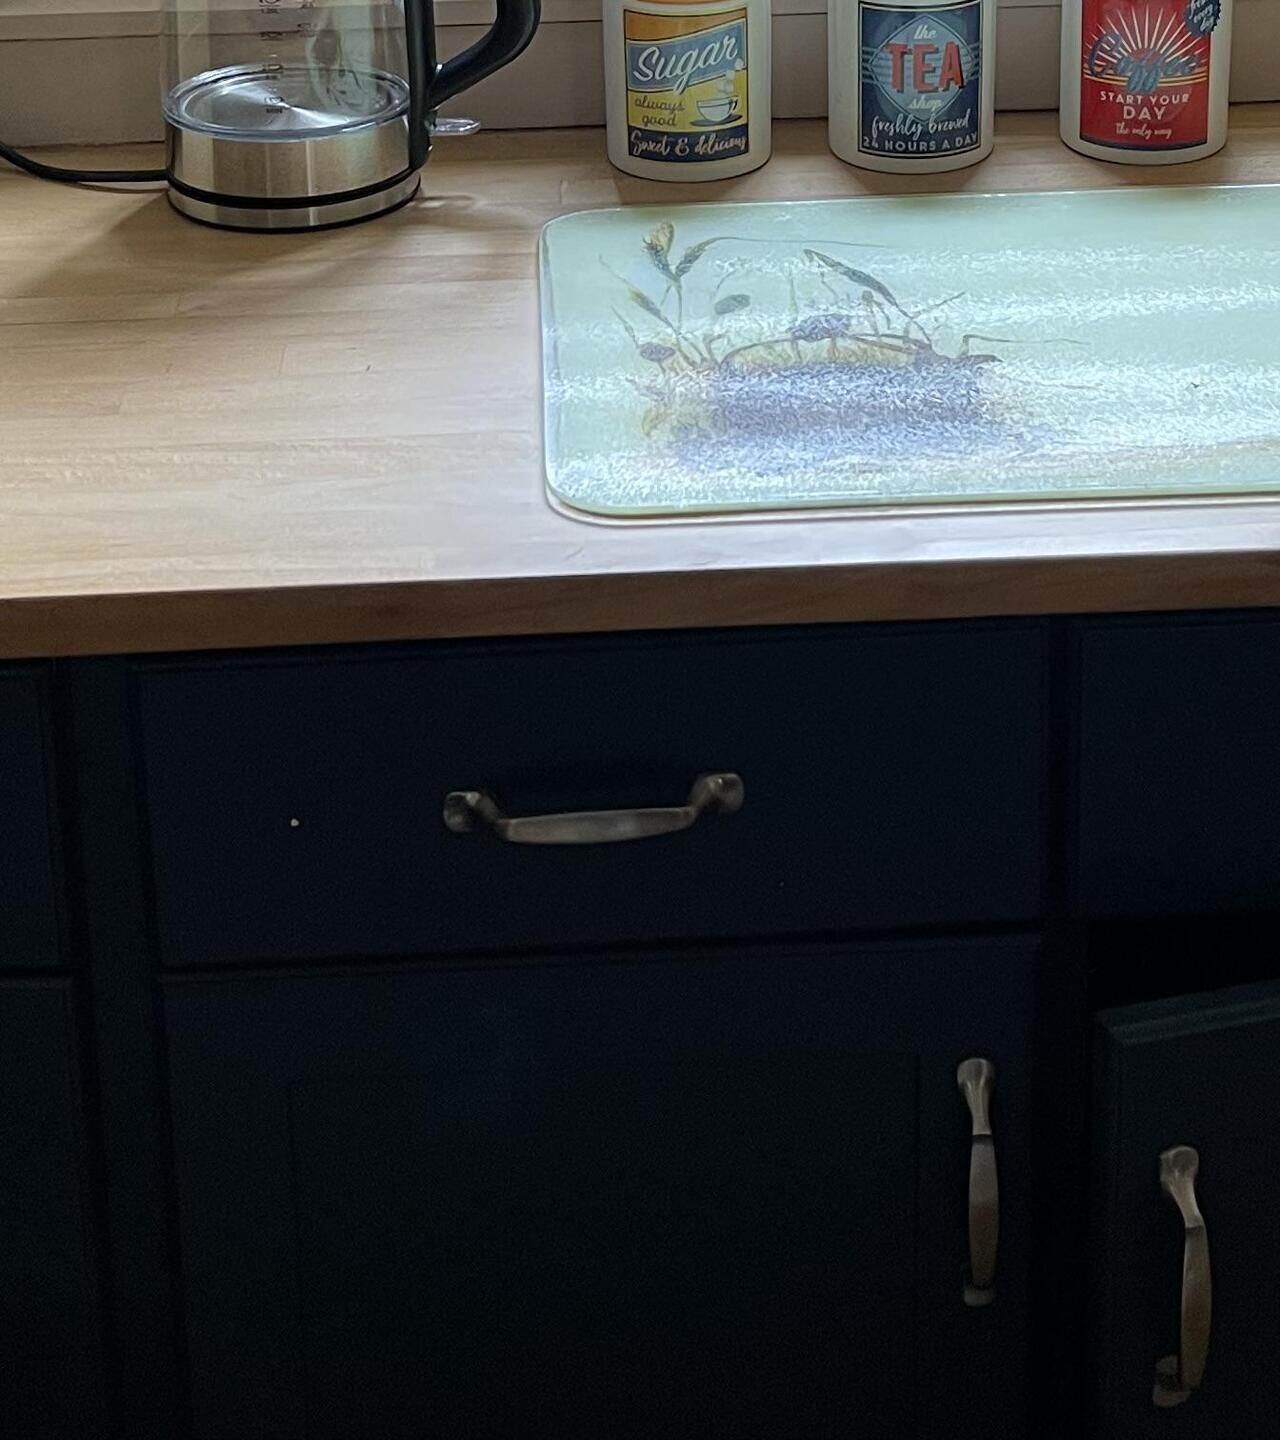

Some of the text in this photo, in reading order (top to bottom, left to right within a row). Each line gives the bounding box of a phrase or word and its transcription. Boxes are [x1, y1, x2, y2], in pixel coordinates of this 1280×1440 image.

[913, 24, 937, 40] the
[633, 35, 738, 95] Sugar
[885, 40, 966, 94] TEA
[634, 95, 685, 115] always
[908, 95, 942, 112] shop
[1100, 91, 1191, 106] START YOUR
[641, 113, 678, 128] good
[871, 107, 971, 140] freshly brewed
[1123, 106, 1167, 121] DAY
[630, 130, 670, 156] Sweet
[694, 133, 747, 156] delicious
[863, 131, 978, 152] 24 HOURS A DAY
